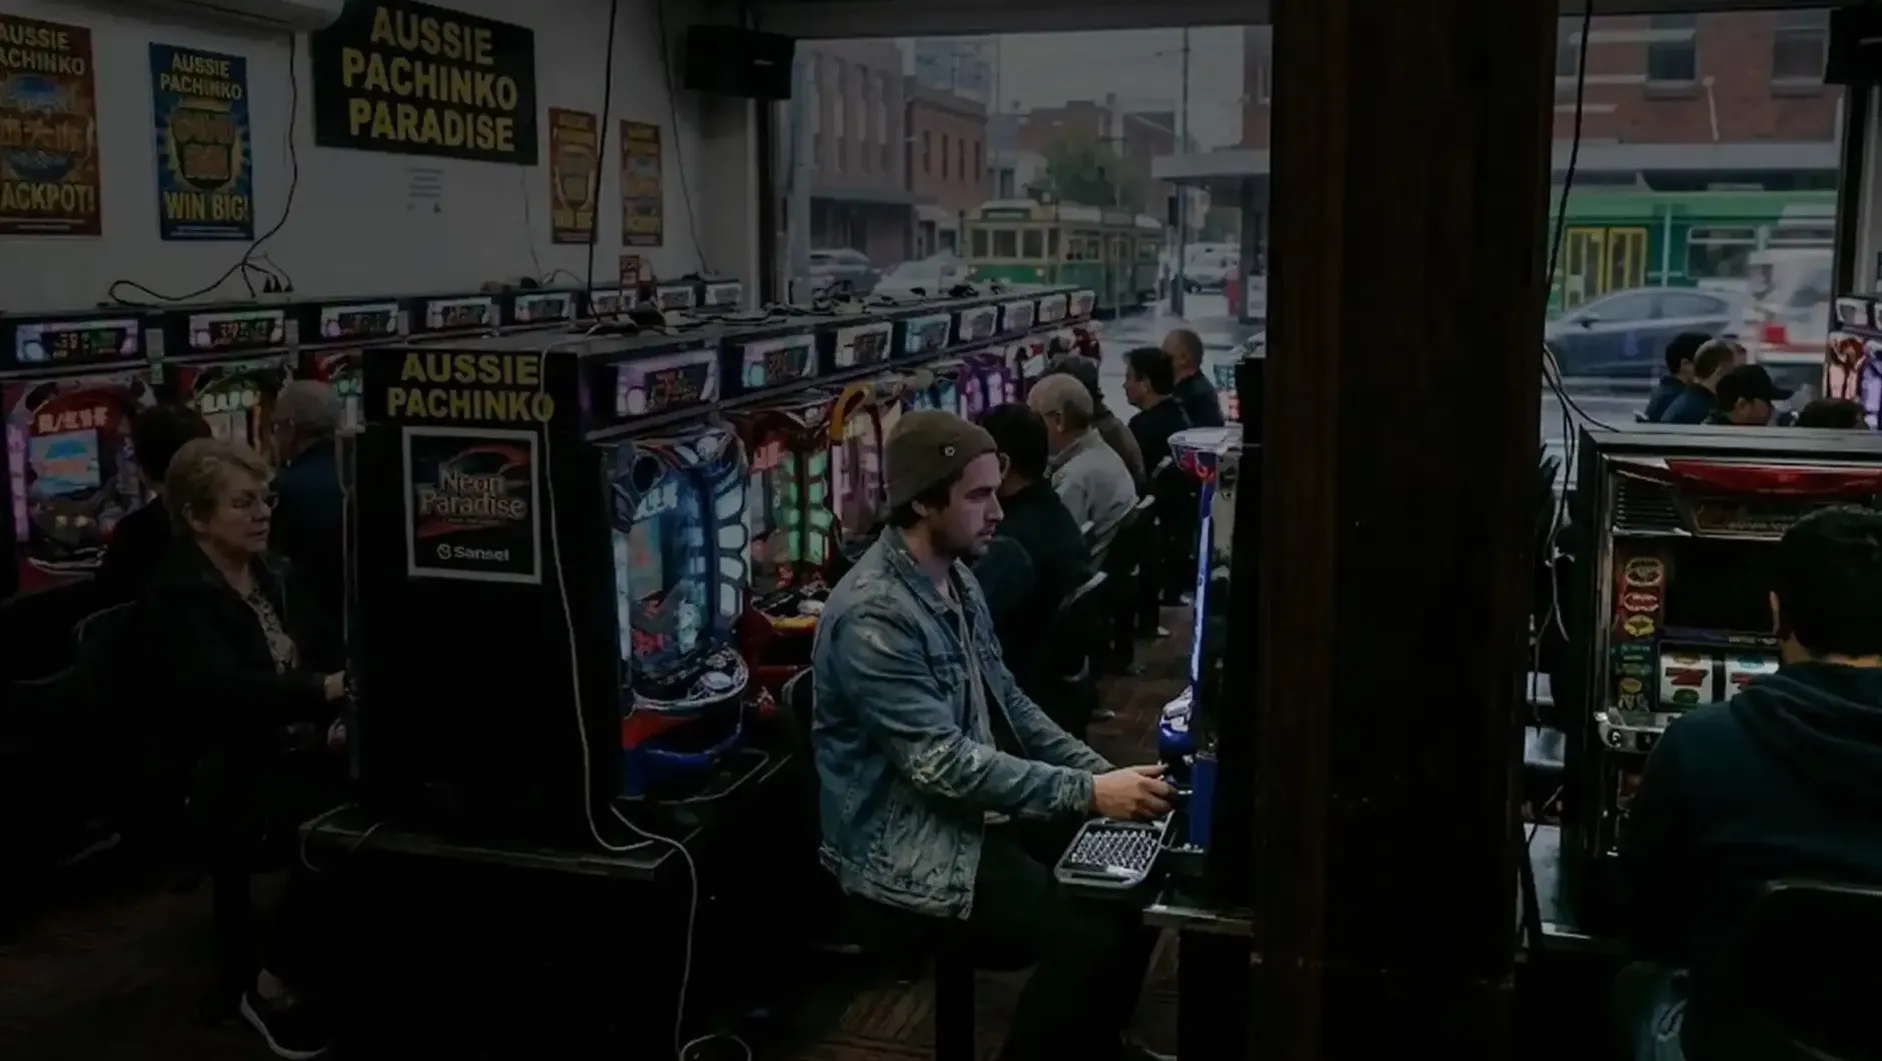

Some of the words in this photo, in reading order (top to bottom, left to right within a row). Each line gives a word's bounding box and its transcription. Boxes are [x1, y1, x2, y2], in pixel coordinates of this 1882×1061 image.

[0, 22, 71, 51] AUSSIE
[370, 6, 495, 66] AUSSIE
[0, 45, 85, 77] ACHINKO
[172, 51, 231, 79] AUSSIE
[160, 72, 243, 100] PACHINKO
[341, 46, 518, 111] PACHINKO
[348, 97, 516, 152] PARADISE
[0, 181, 95, 213] ACKPOT!
[164, 191, 206, 221] WIN
[212, 193, 249, 222] BIG!
[401, 352, 541, 386] AUSSIE
[386, 386, 556, 424] PACHINKO
[440, 467, 507, 497] Neon
[418, 487, 527, 521] Paradise
